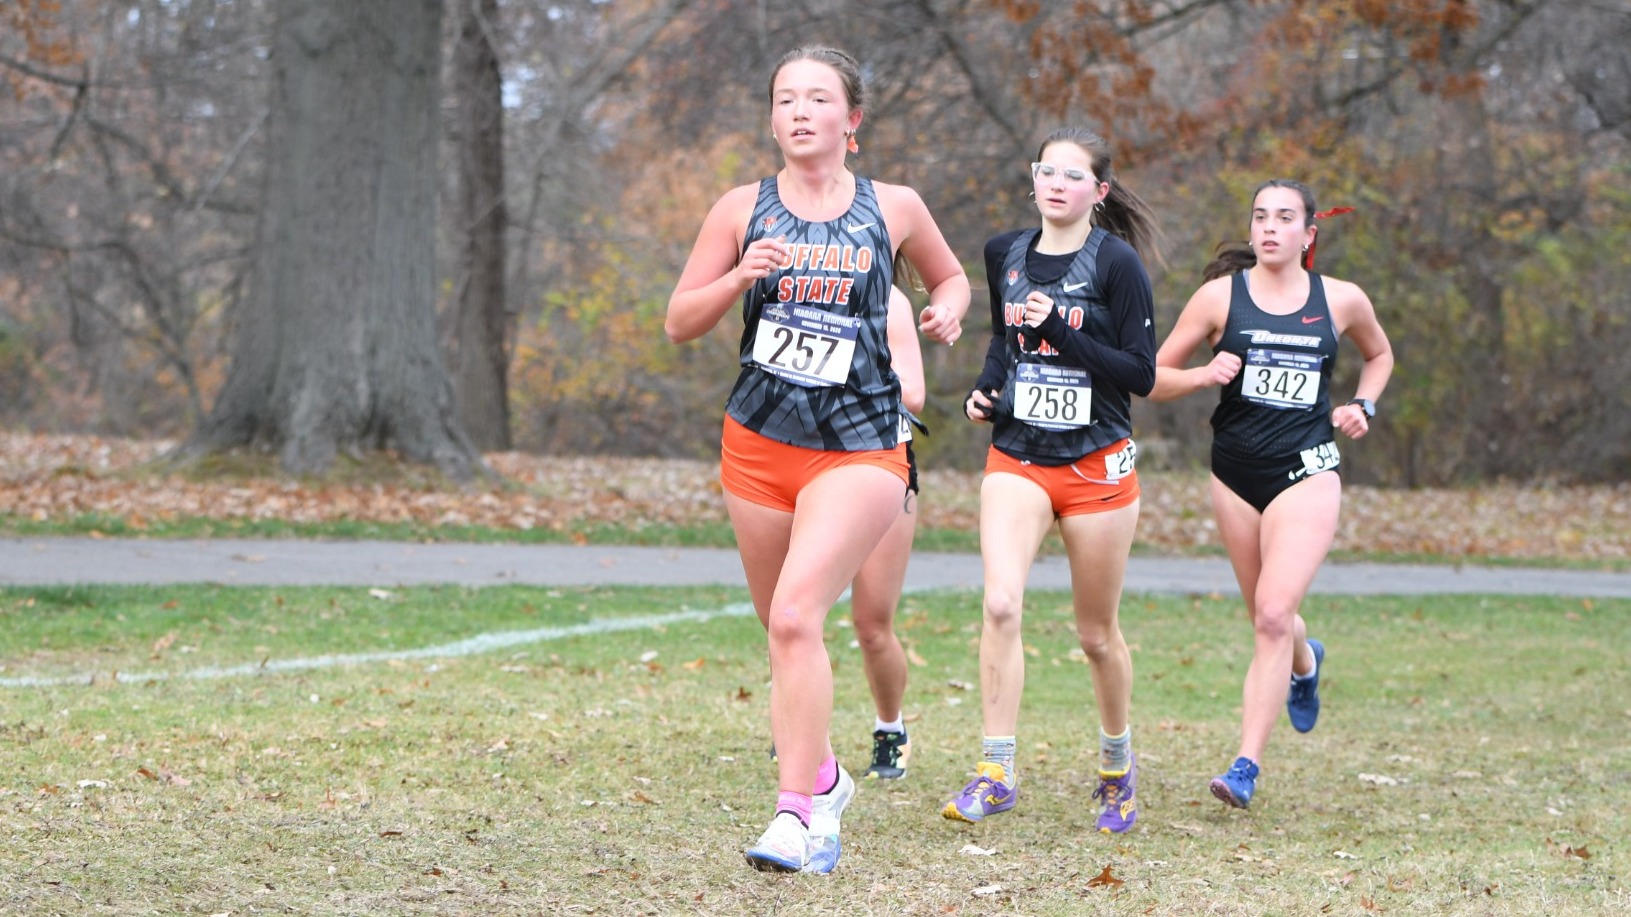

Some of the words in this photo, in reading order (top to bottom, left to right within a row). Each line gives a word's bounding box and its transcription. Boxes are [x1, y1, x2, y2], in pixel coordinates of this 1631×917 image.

[779, 243, 872, 273] UFFALO
[778, 276, 854, 305] STATE
[768, 327, 839, 375] 257
[1255, 368, 1307, 401] 342
[1027, 386, 1078, 421] 258
[1311, 443, 1338, 469] 34
